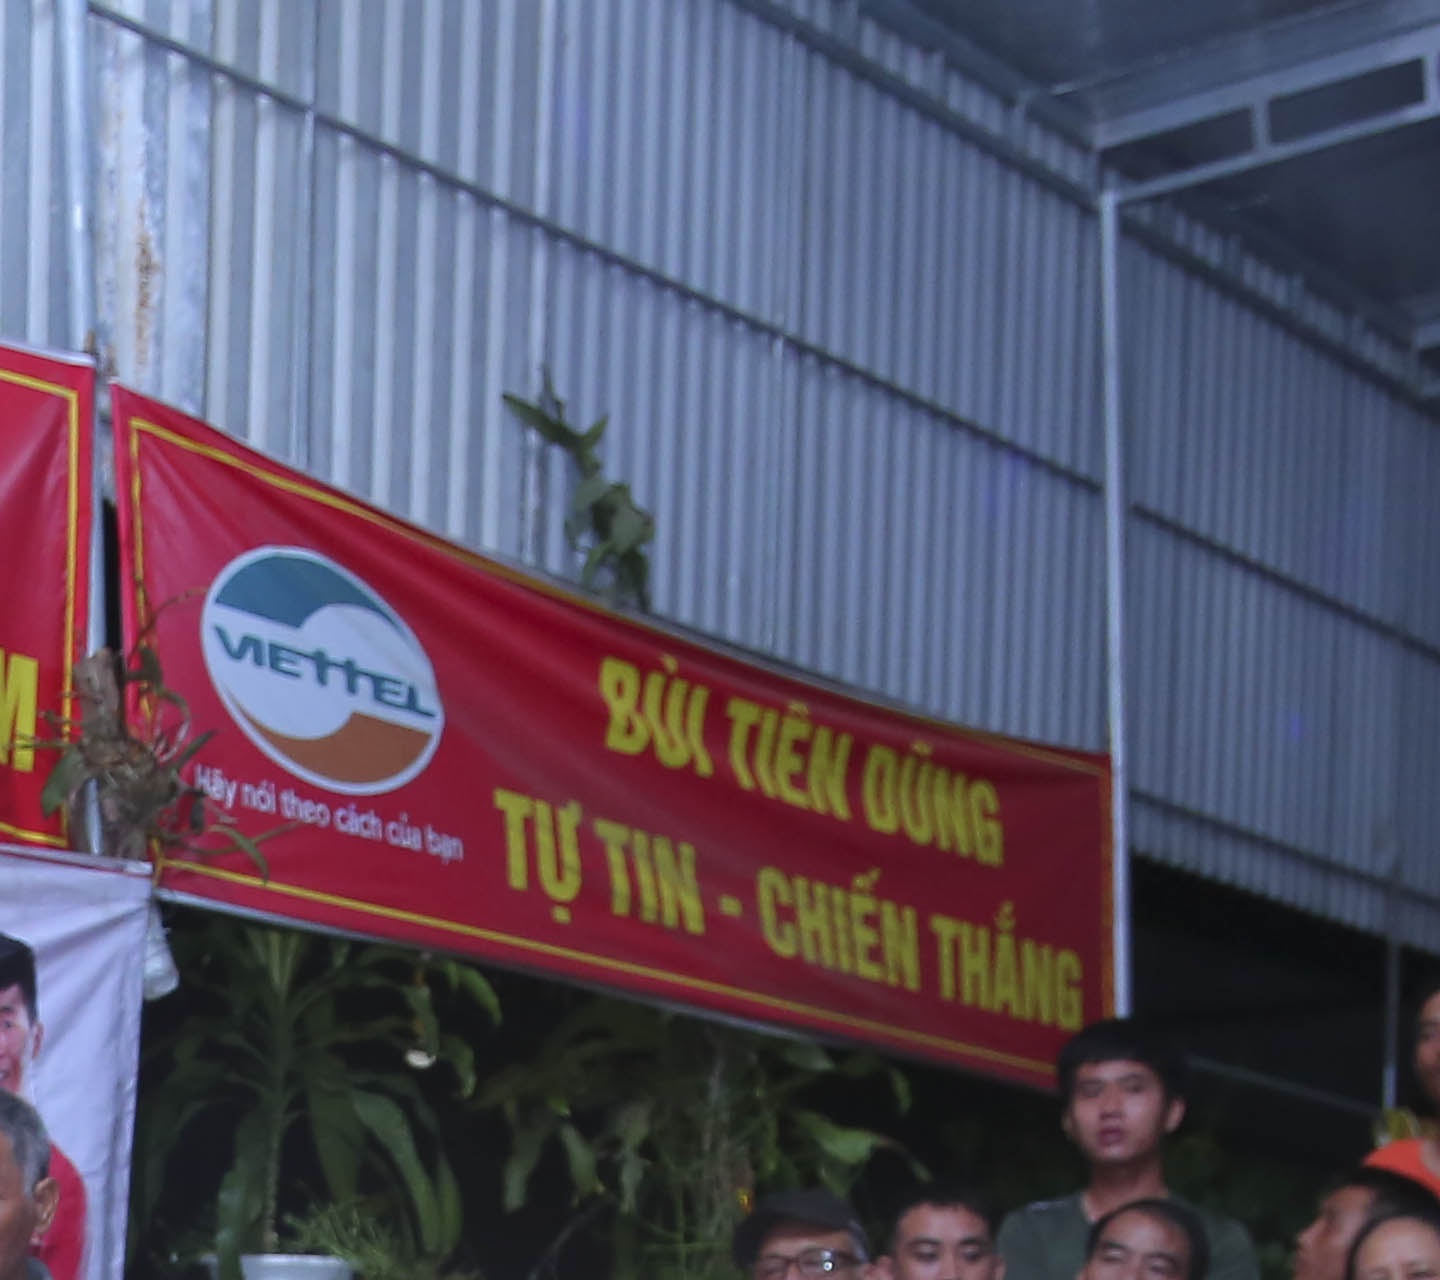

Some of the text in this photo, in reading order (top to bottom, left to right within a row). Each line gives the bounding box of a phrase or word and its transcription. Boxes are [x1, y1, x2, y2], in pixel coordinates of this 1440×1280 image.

[213, 622, 437, 720] VIETTEL
[599, 653, 713, 778] BÙI
[241, 780, 277, 814] nói
[280, 791, 331, 829] theo
[333, 801, 383, 840] cách
[385, 812, 422, 851] của
[425, 826, 465, 866] bạn
[494, 787, 1085, 1032] TỰ TIN - CHIẾN THẮNG
